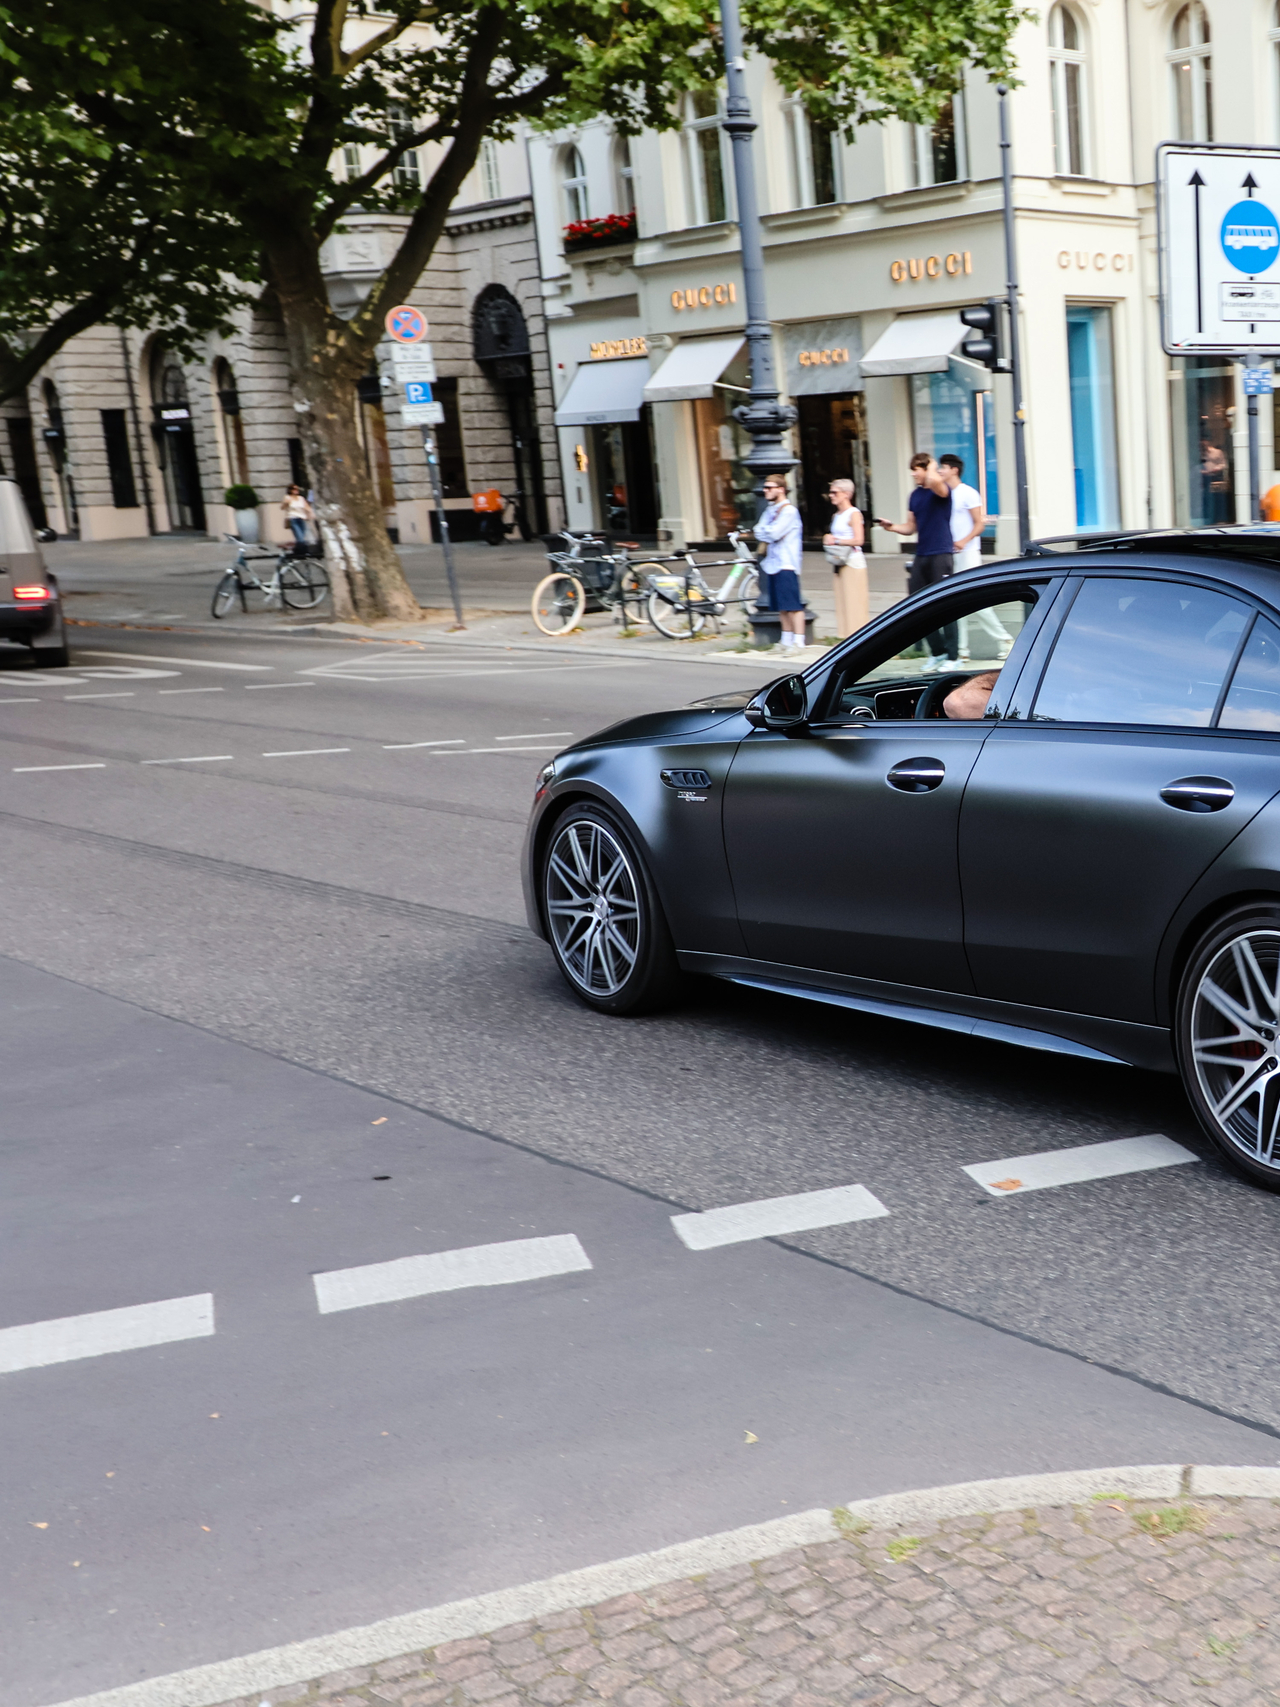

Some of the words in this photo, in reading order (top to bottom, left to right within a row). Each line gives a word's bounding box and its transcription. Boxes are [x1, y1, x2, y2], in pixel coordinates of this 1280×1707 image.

[890, 251, 973, 282] GUCCI
[1057, 250, 1134, 272] GUCCI
[671, 283, 737, 310] GUCCI
[799, 348, 849, 367] GUCCI
[408, 384, 424, 402] P
